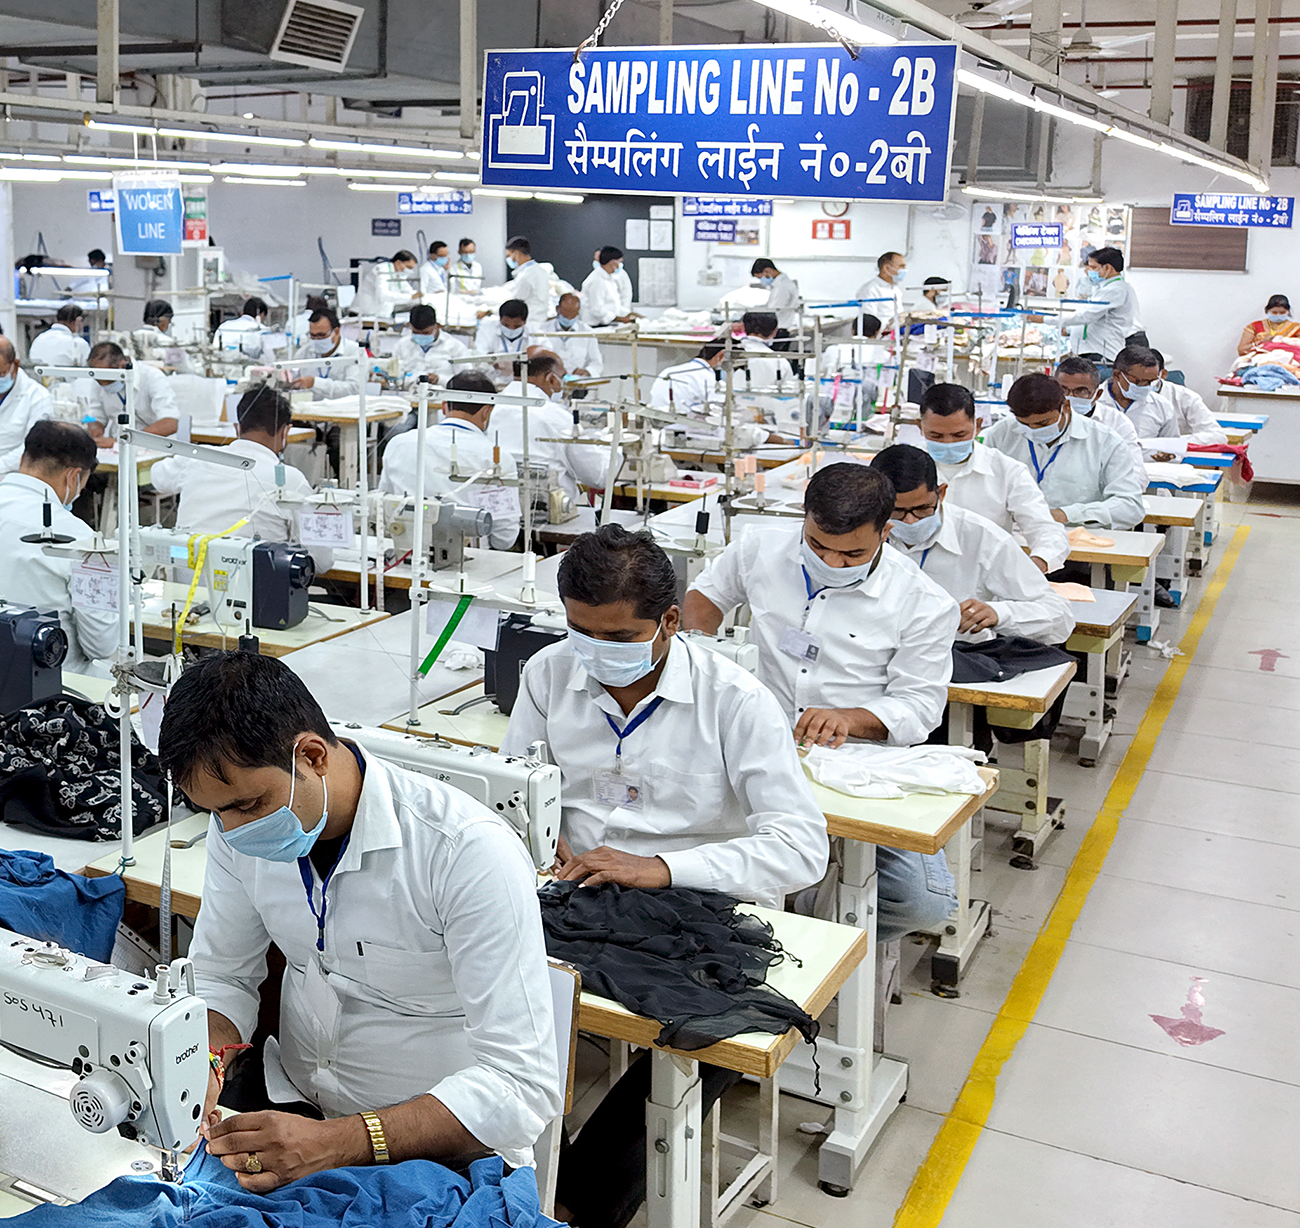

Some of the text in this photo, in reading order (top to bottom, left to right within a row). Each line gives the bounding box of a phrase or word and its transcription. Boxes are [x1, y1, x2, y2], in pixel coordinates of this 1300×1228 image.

[567, 59, 720, 114] SAMPLING
[730, 58, 803, 115] LINE
[814, 58, 858, 116] No
[888, 57, 937, 116] 2B
[564, 121, 684, 178] सैम्पलिंग
[696, 122, 785, 191] लाईन
[126, 192, 174, 211] WOVEN
[1194, 195, 1237, 210] SAMPLING
[1238, 196, 1258, 210] LINE
[1259, 196, 1271, 211] No
[1276, 197, 1288, 211] 2B
[137, 222, 166, 240] LINE
[175, 1042, 200, 1065] brother
